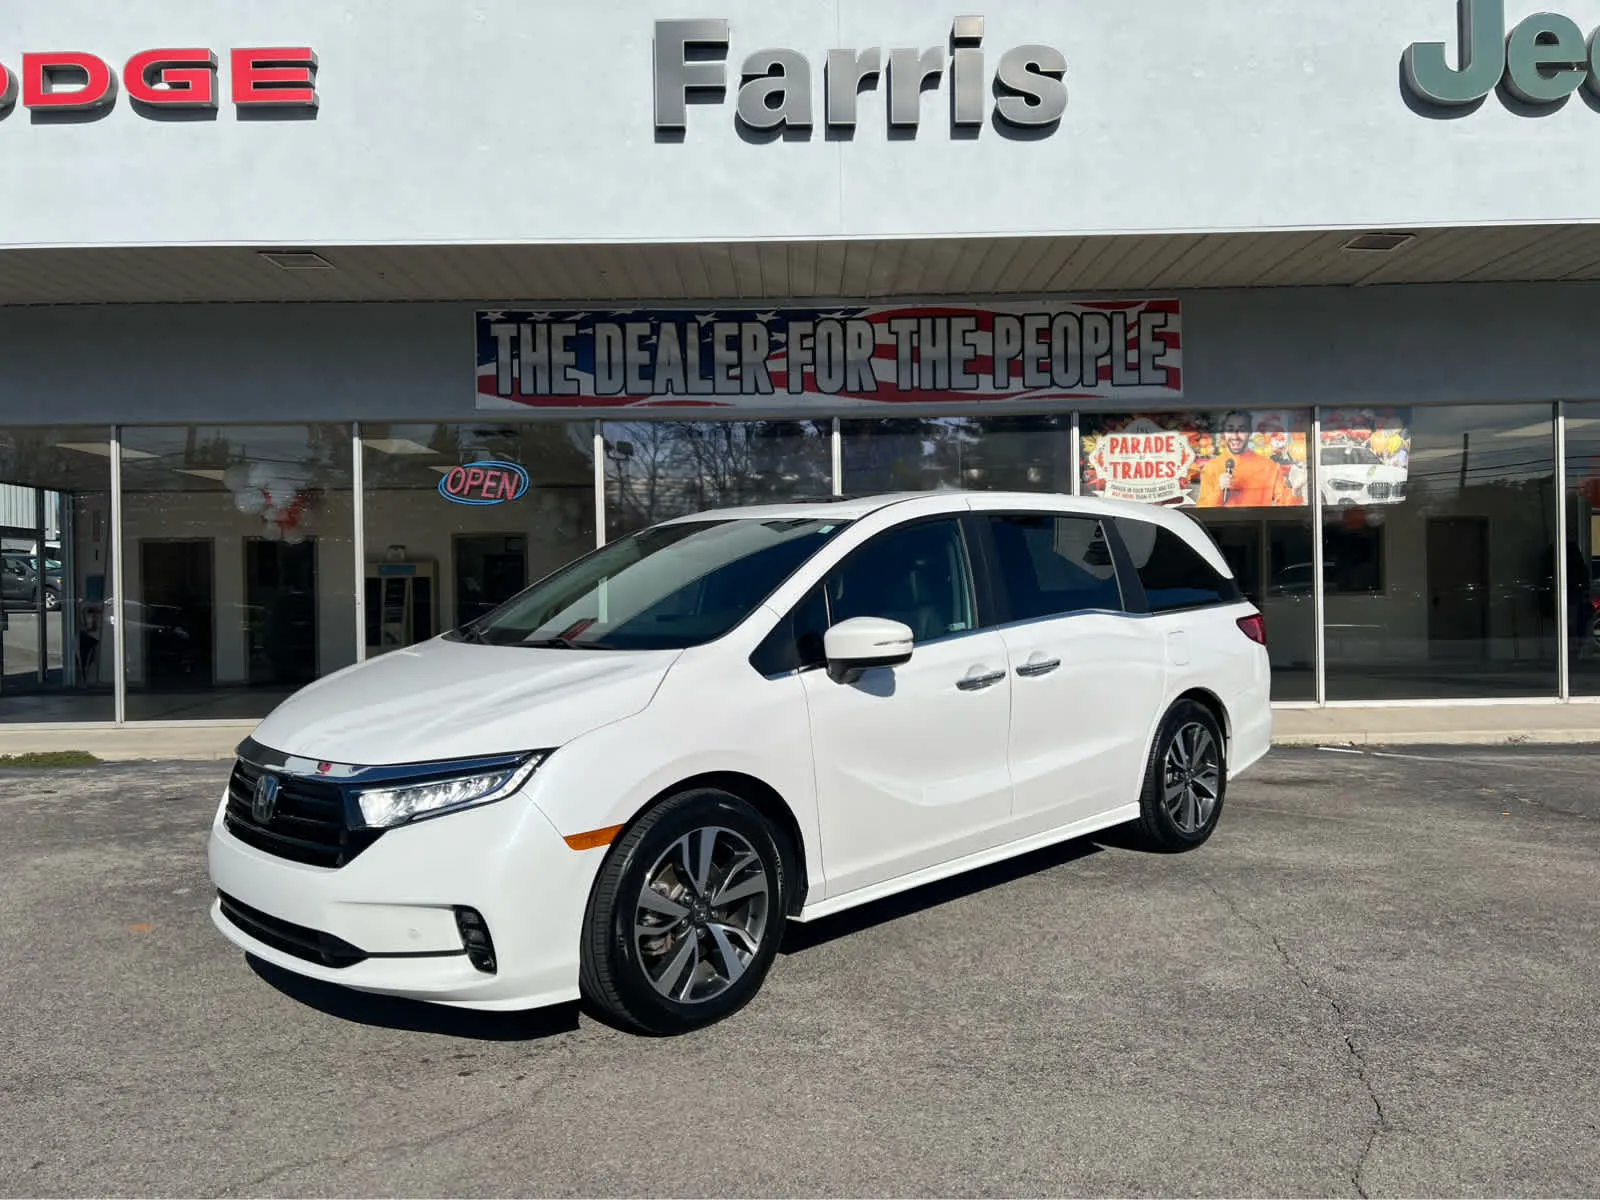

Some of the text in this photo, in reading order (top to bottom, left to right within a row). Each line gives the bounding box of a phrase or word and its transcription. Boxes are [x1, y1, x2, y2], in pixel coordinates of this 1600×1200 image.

[0, 47, 319, 110] DGE
[654, 15, 1069, 130] Farris
[1403, 0, 1600, 105] Je
[490, 311, 1169, 395] THE DEALER FOR THE PEOPLE
[1108, 461, 1177, 480] TRADES
[1109, 435, 1175, 455] PARADE
[446, 466, 519, 501] OPEN
